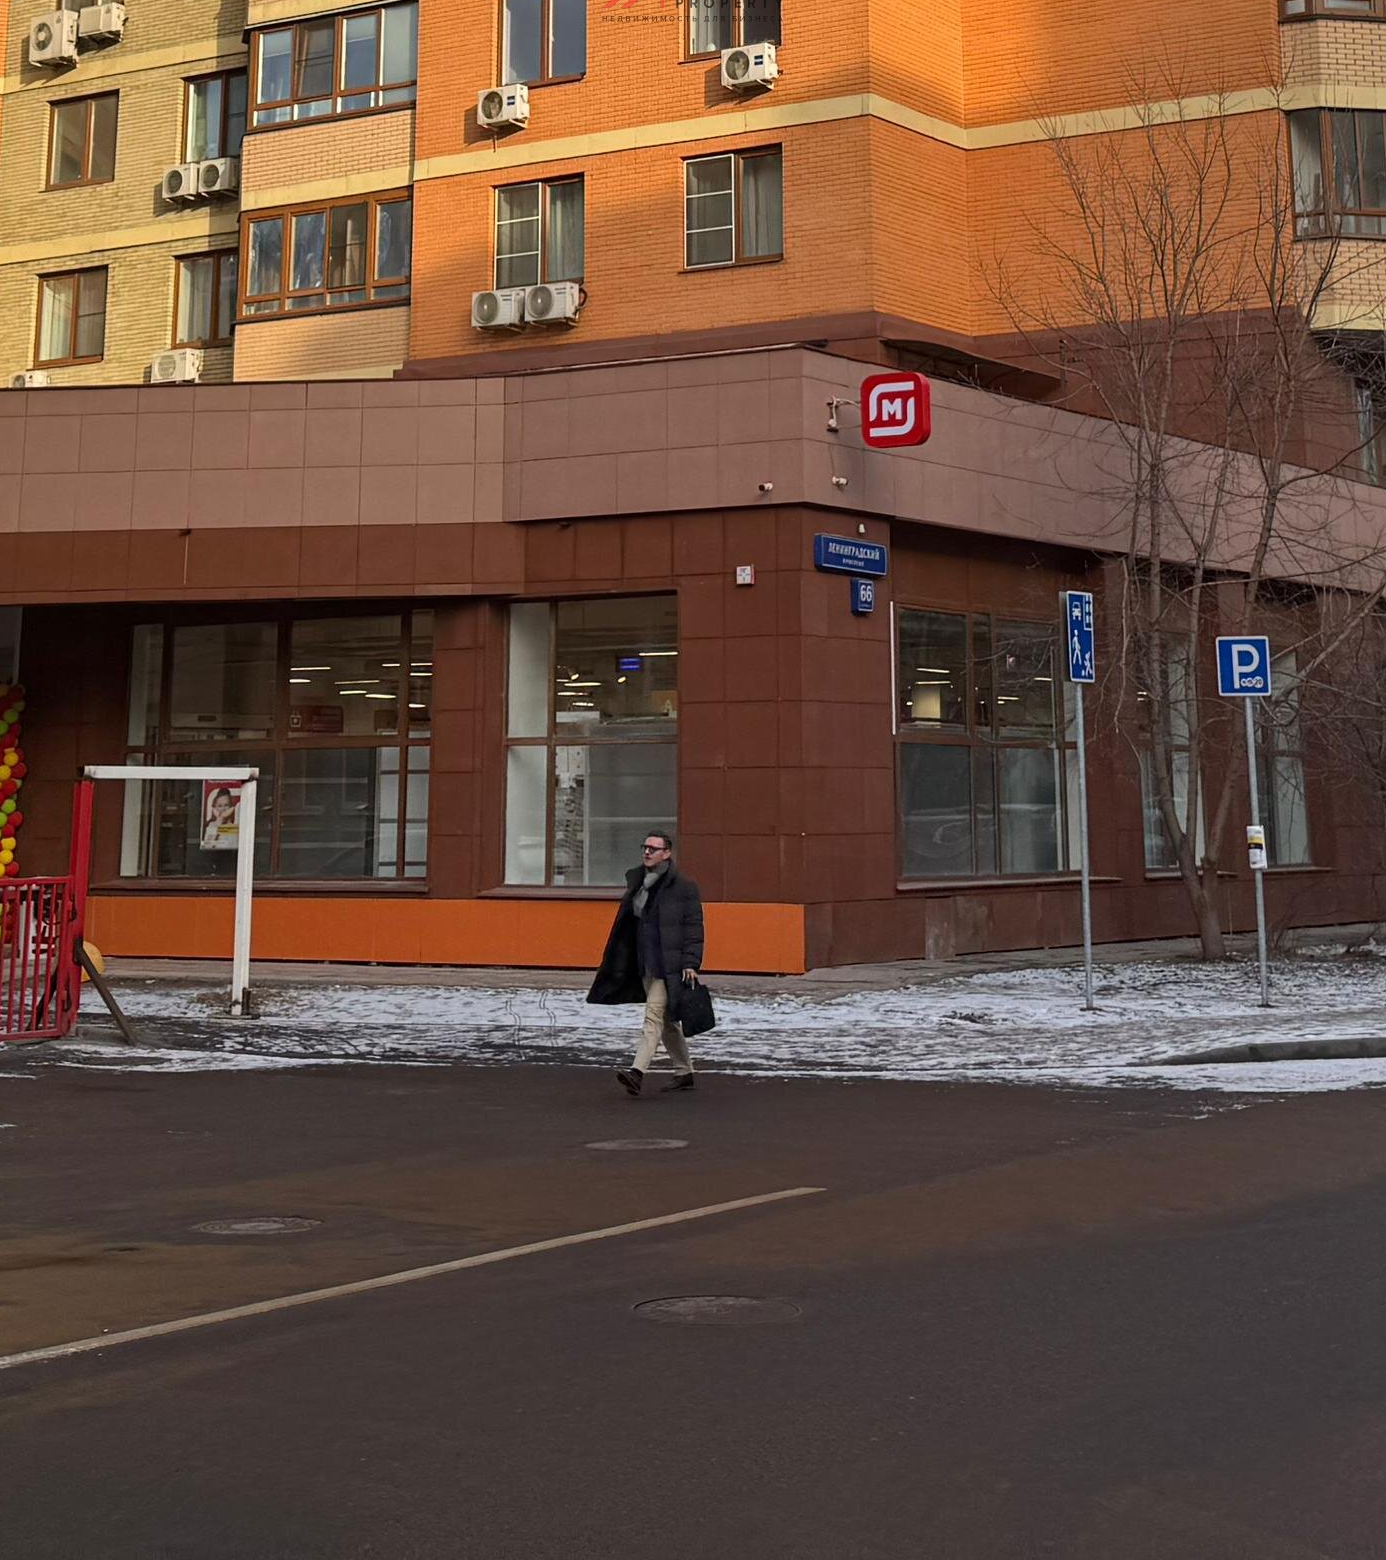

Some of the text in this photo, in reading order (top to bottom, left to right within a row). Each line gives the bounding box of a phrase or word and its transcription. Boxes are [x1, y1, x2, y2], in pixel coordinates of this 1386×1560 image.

[828, 542, 880, 561] ЛЕНИНГРАДСКИЙ
[860, 585, 873, 602] 66
[1231, 644, 1260, 689] P
